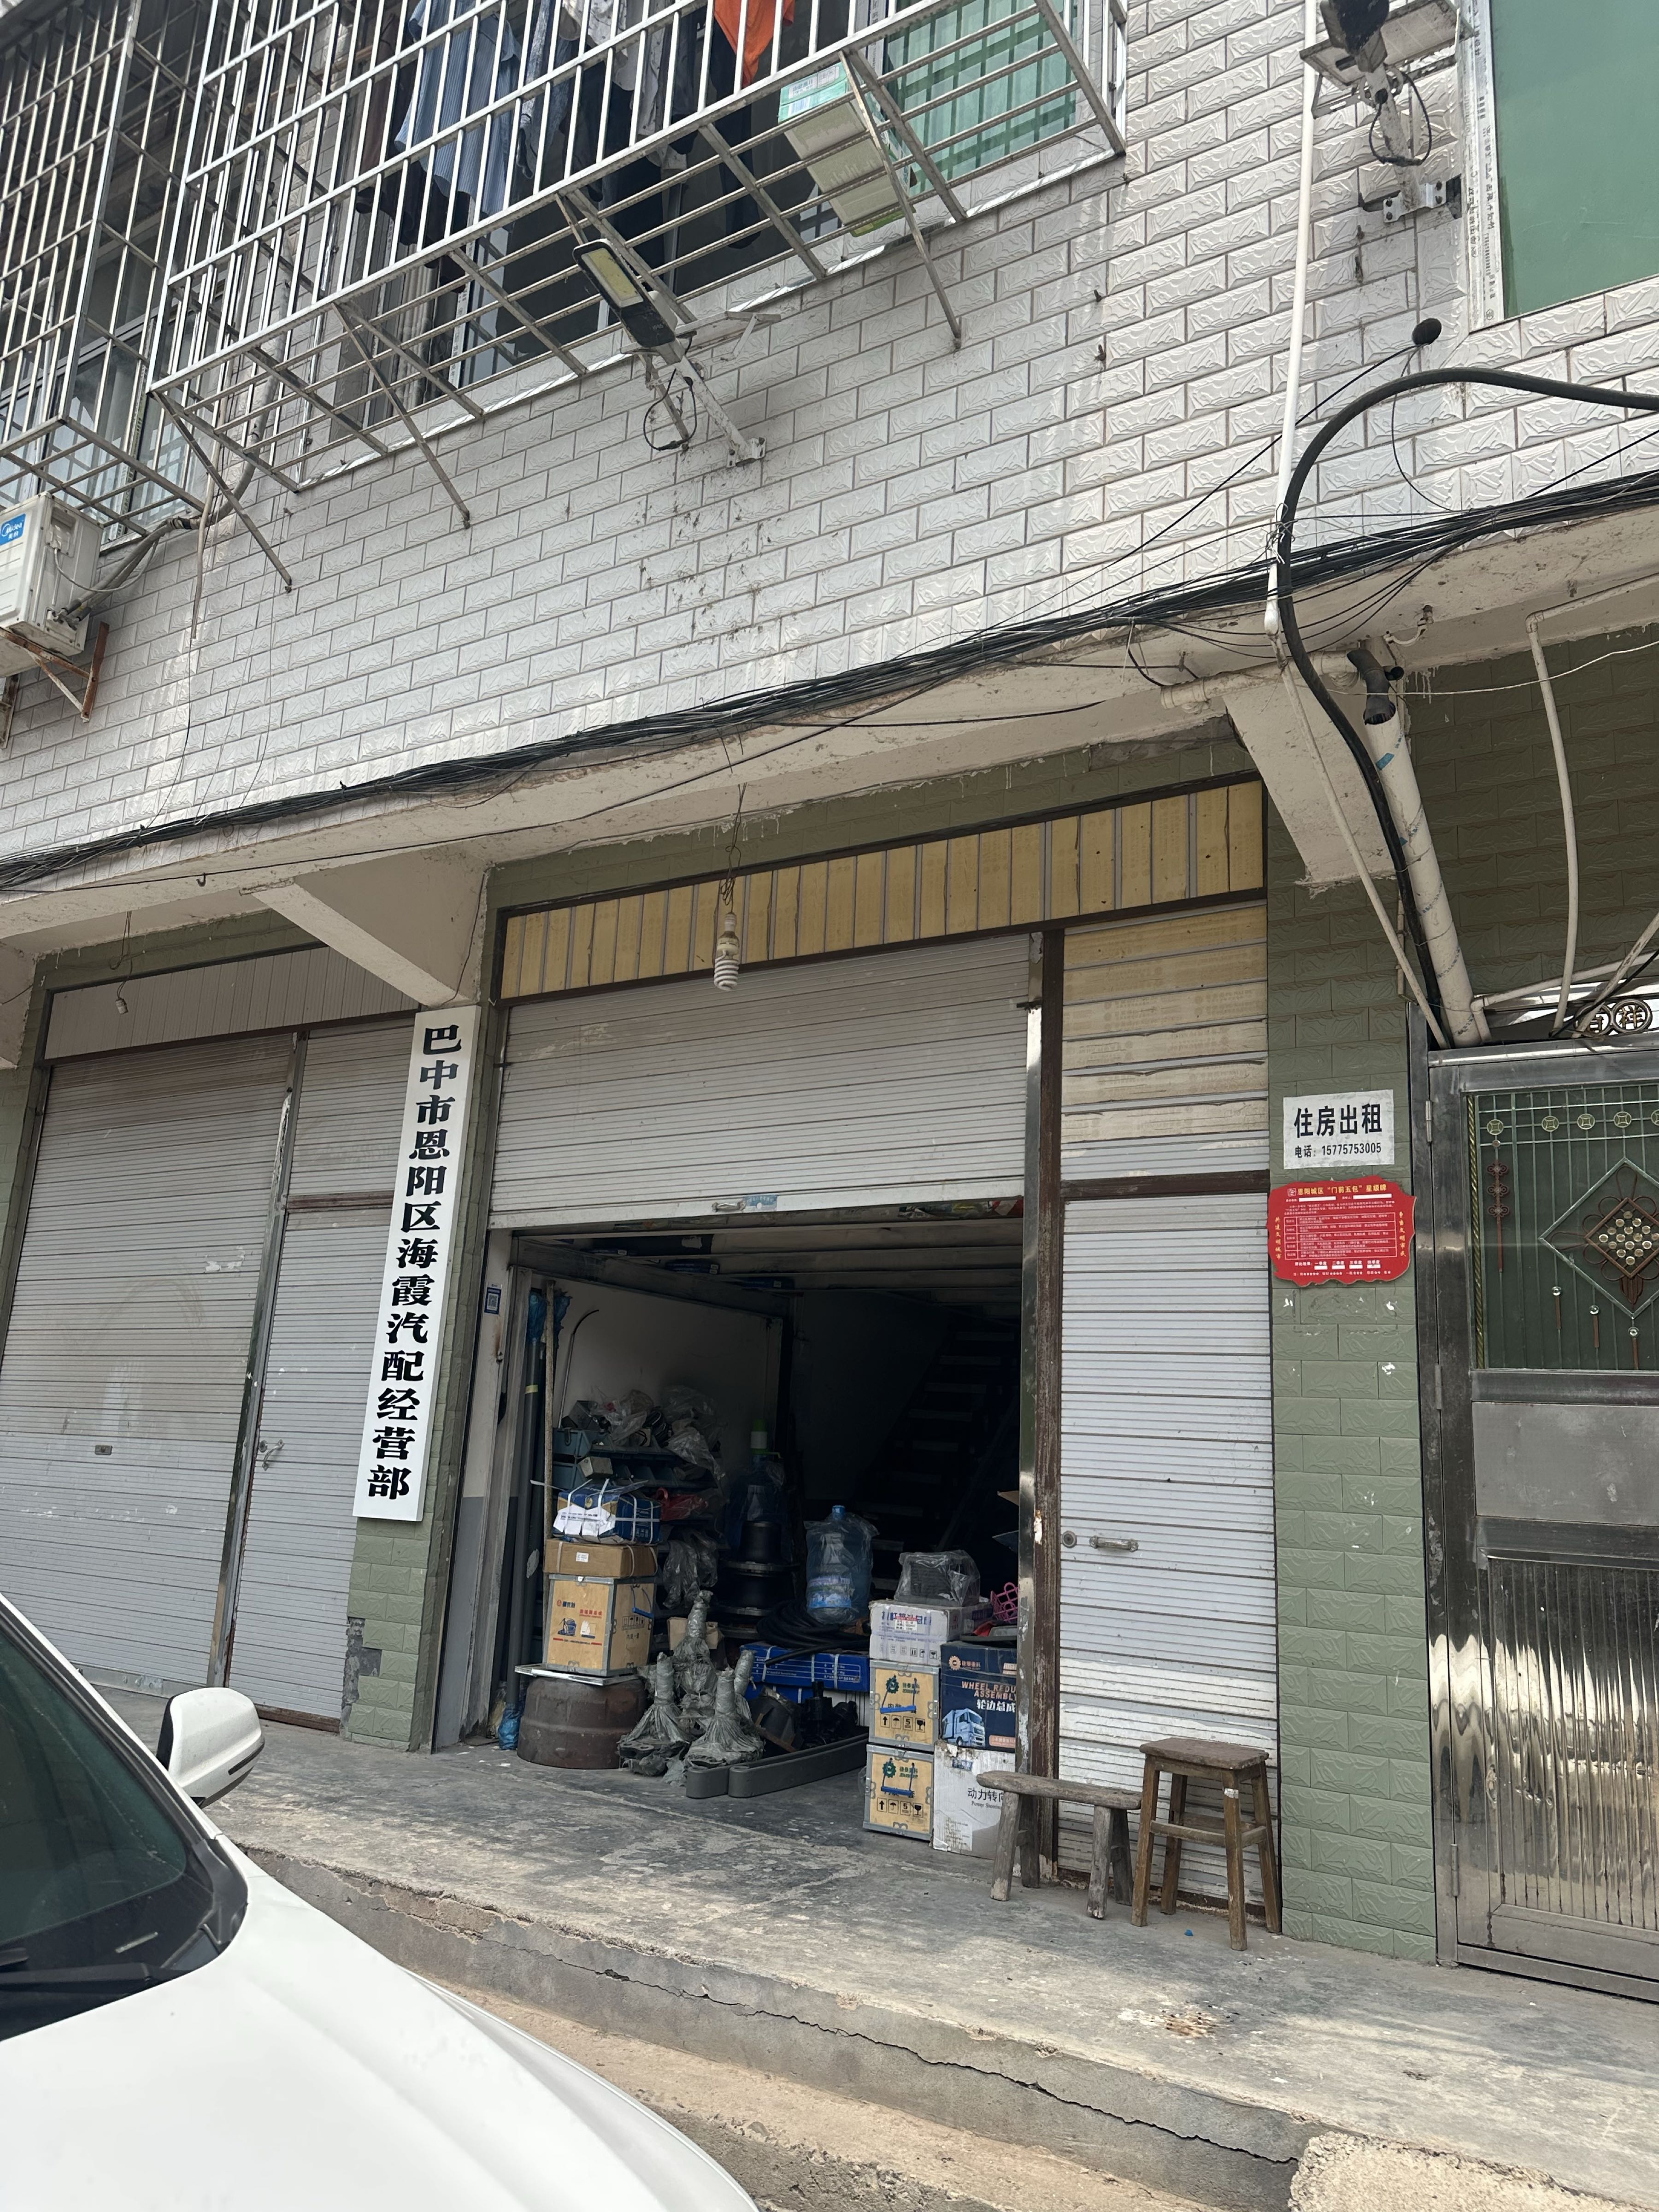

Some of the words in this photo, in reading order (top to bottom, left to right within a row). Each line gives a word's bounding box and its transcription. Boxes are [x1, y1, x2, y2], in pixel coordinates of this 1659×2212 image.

[1294, 1103, 1382, 1138] 住房出租
[367, 1024, 462, 1500] 巴中市恩阳区海霞汽配经营部
[962, 1681, 990, 1691] WHEEL
[977, 1699, 1016, 1713] 轮边总成
